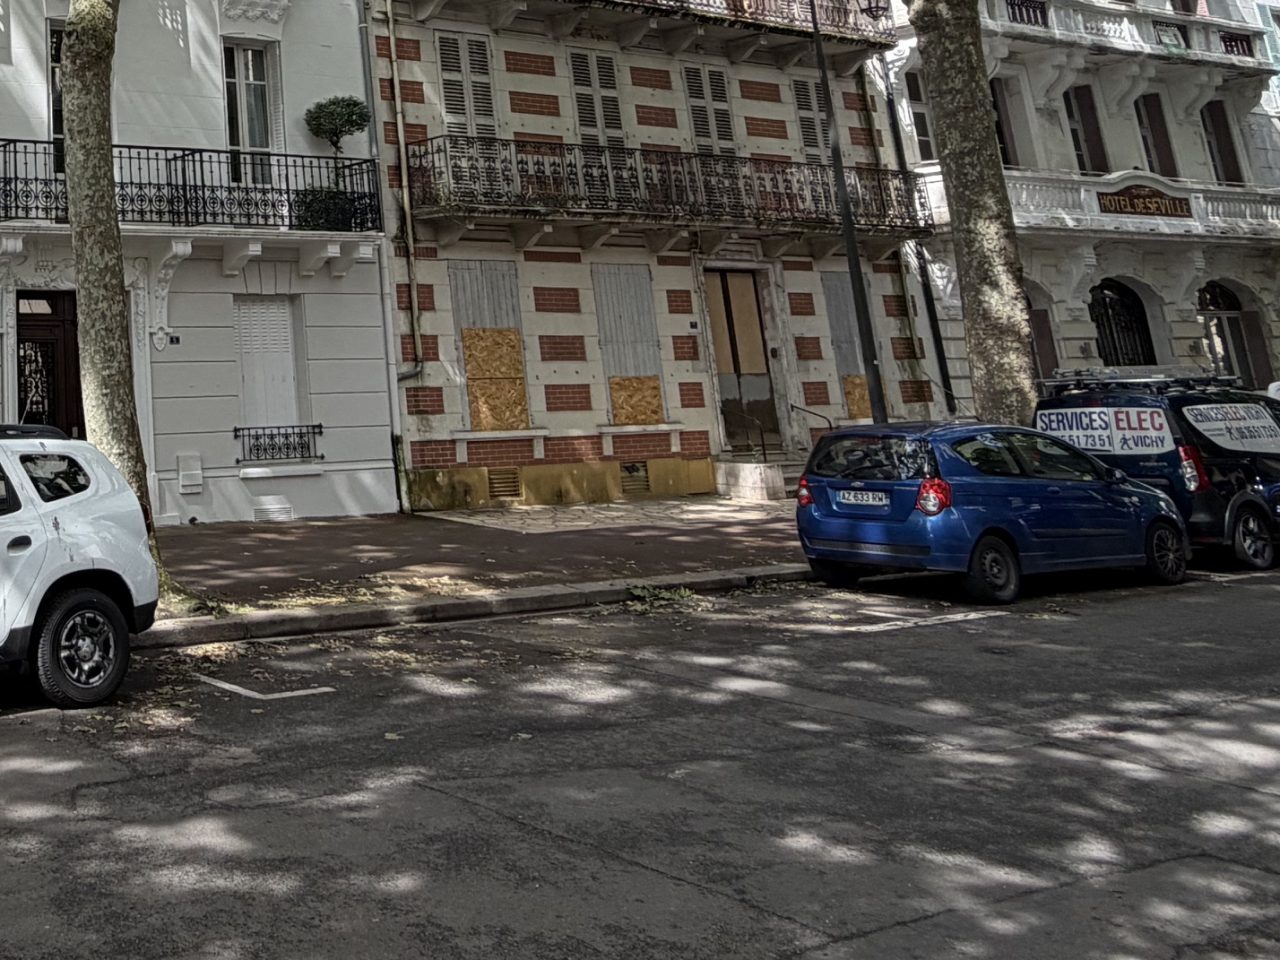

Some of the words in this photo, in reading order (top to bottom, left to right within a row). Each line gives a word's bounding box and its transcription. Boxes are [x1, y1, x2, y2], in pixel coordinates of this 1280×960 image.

[1146, 198, 1190, 216] SEVILLE
[1039, 410, 1109, 433] SERVICES
[1114, 408, 1163, 431] ÉLEC
[1131, 435, 1165, 448] VICHY
